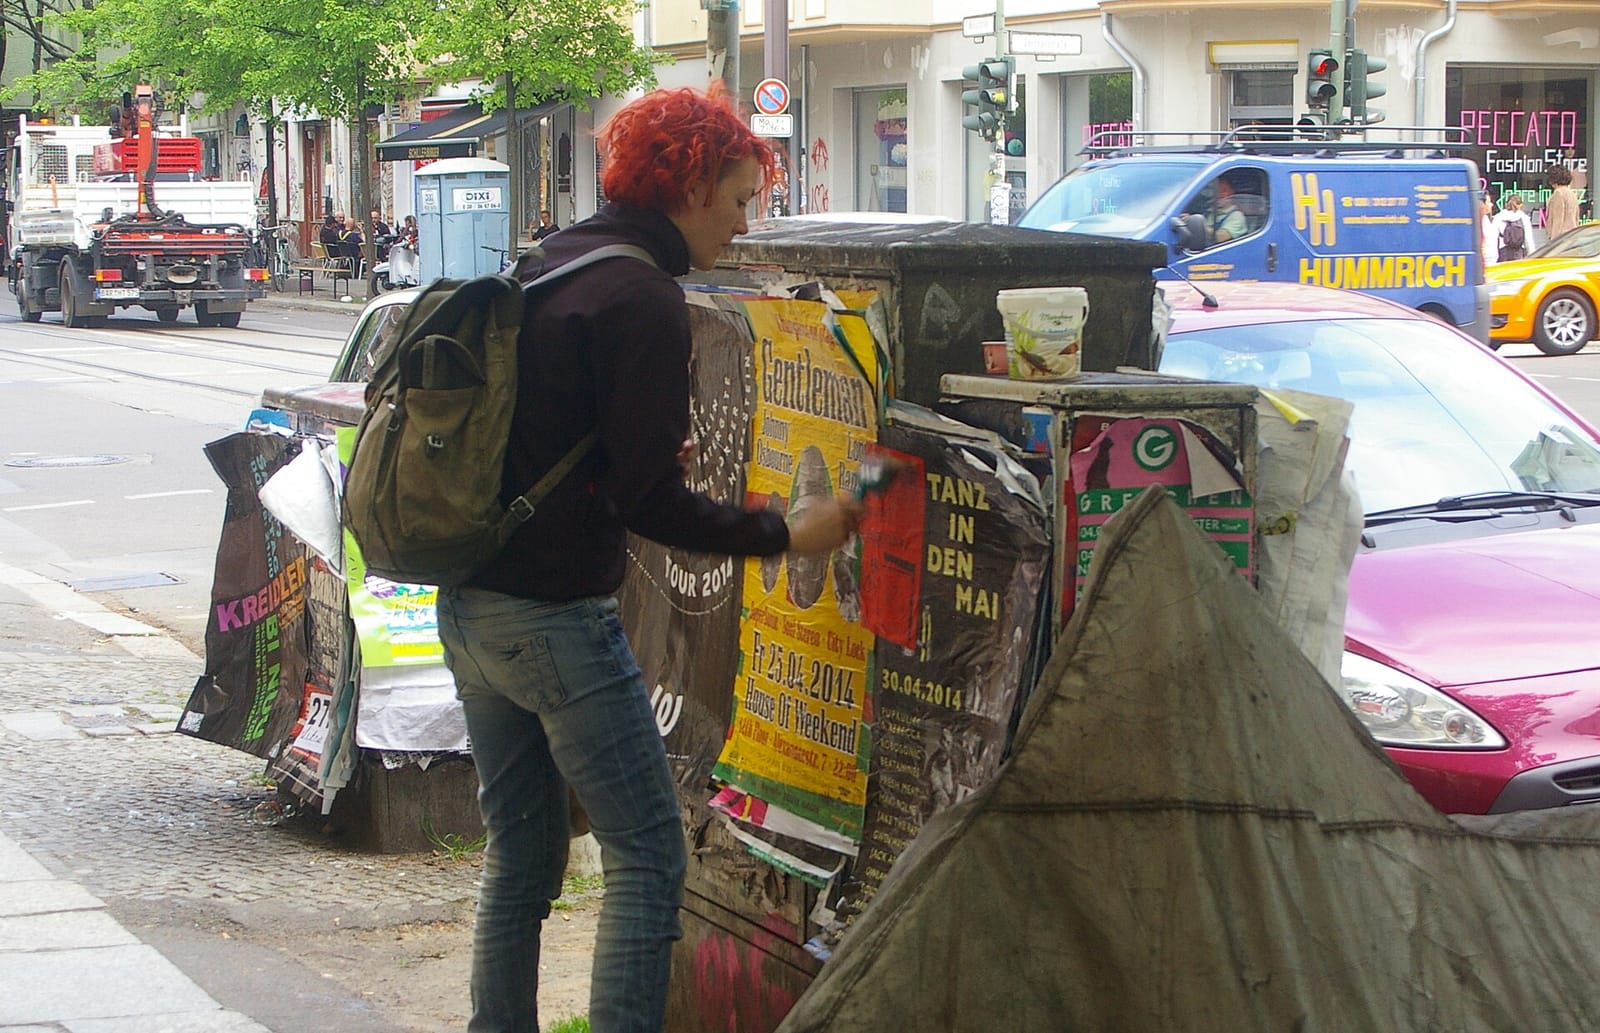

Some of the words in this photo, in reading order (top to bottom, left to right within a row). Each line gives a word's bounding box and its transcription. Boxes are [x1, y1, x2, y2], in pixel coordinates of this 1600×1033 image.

[1460, 110, 1577, 147] PECCATO
[1486, 149, 1542, 173] Fashion
[1299, 255, 1466, 289] HUMMRICH
[761, 336, 868, 429] Gentleman
[1136, 427, 1174, 467] G
[926, 472, 990, 511] TANZ
[949, 513, 975, 544] IN
[665, 554, 697, 598] TOUR
[702, 555, 734, 598] 2014
[927, 544, 974, 581] DEN
[216, 555, 306, 633] KREIDLER
[955, 583, 999, 621] MAI
[751, 629, 765, 675] Fr
[766, 640, 856, 711] 25.04.2014
[881, 667, 962, 712] 30.04.2014
[744, 676, 776, 723] House
[794, 697, 857, 755] Weekend
